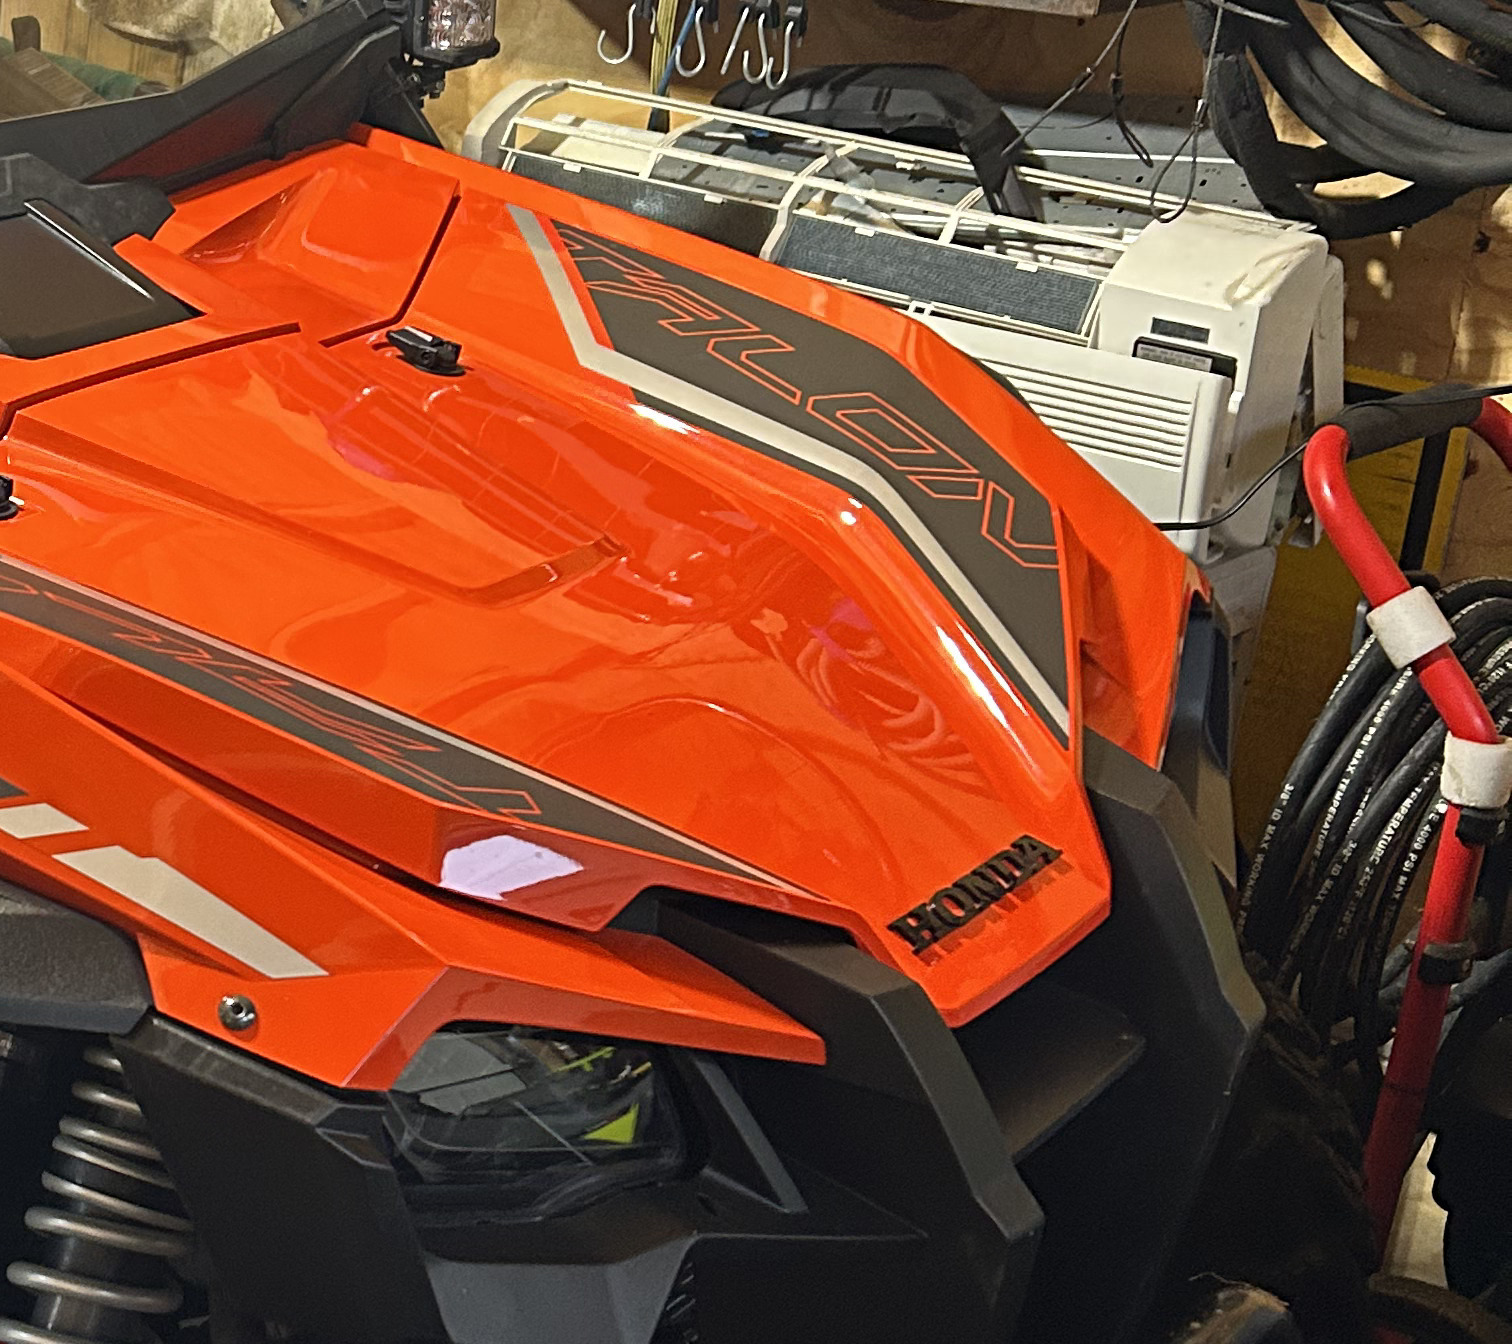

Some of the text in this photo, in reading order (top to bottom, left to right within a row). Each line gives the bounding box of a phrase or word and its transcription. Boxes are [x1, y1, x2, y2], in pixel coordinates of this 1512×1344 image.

[1359, 724, 1377, 747] PSI
[1345, 746, 1365, 774] MAX
[1259, 822, 1276, 850] MAX
[1368, 783, 1423, 865] TEMPERATURE
[1400, 850, 1419, 874] PSI
[886, 833, 1064, 955] HONDA
